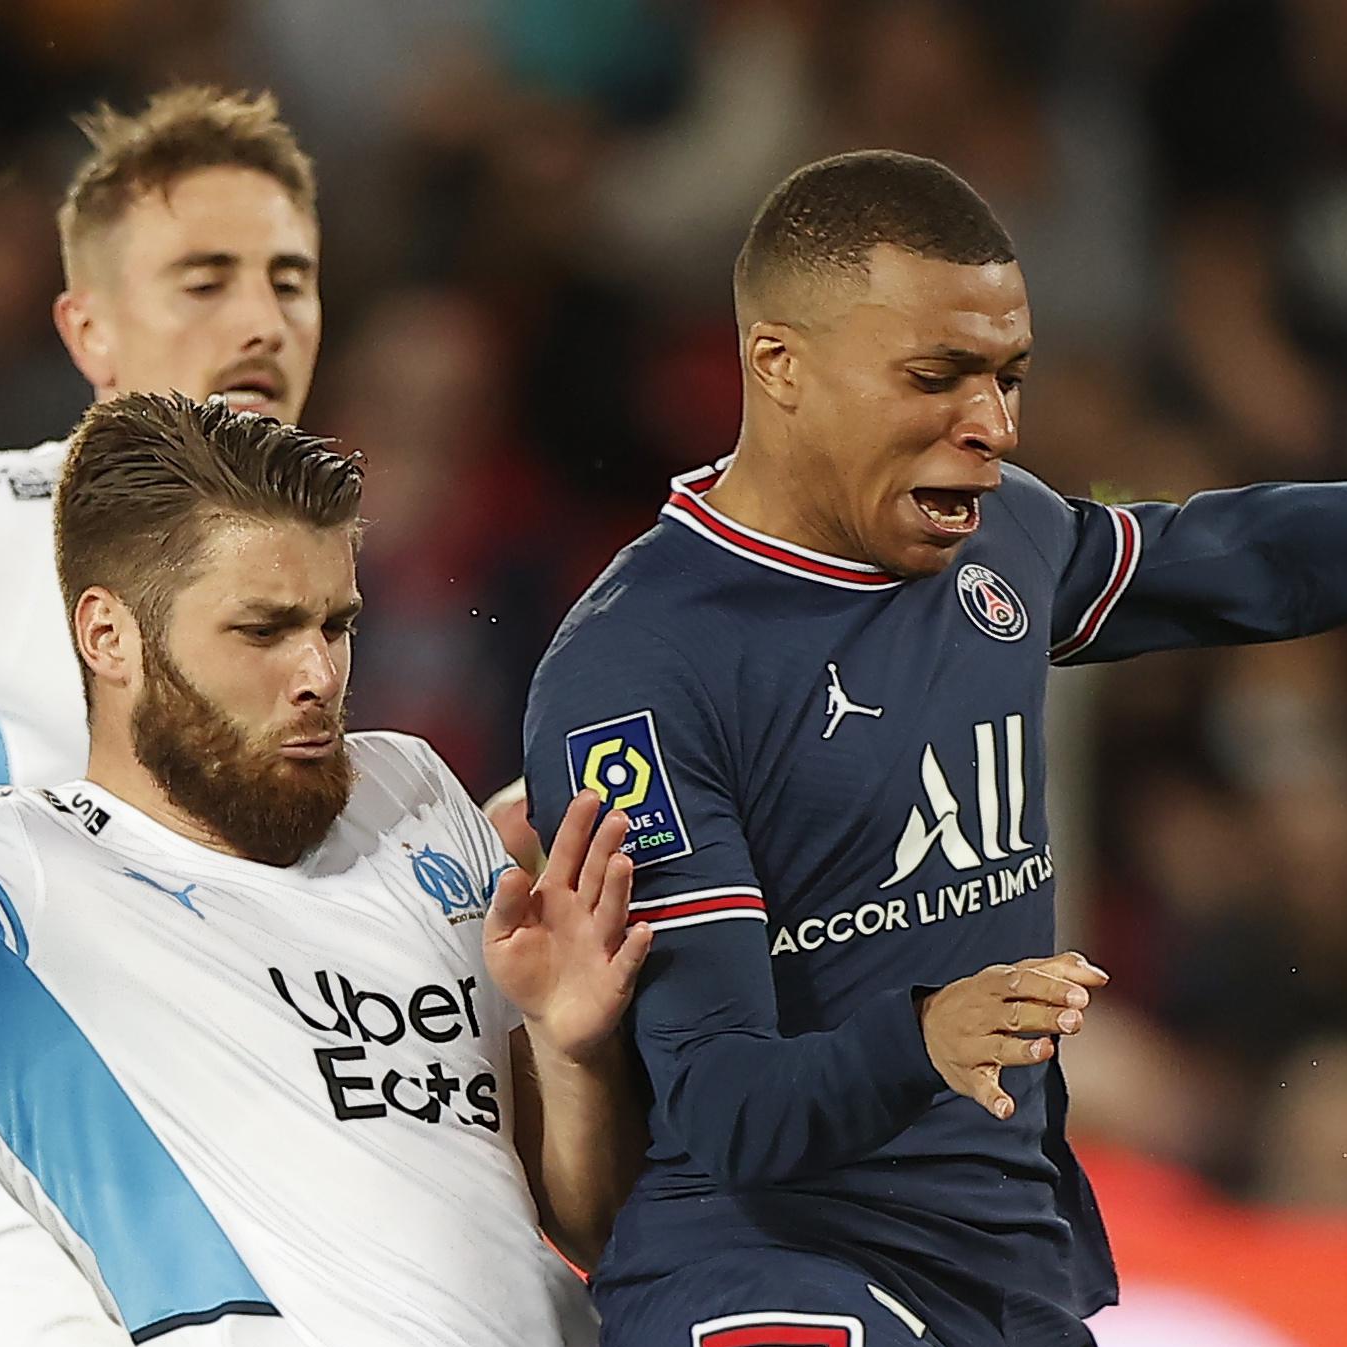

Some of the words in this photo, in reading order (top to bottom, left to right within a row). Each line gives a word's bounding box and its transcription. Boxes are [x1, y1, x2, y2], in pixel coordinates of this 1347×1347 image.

[638, 831, 676, 849] Eats
[654, 811, 665, 825] 1
[770, 898, 910, 956] ACCOR
[916, 879, 983, 925] LIVE
[267, 967, 482, 1046] Uber
[313, 1045, 501, 1134] Eats
